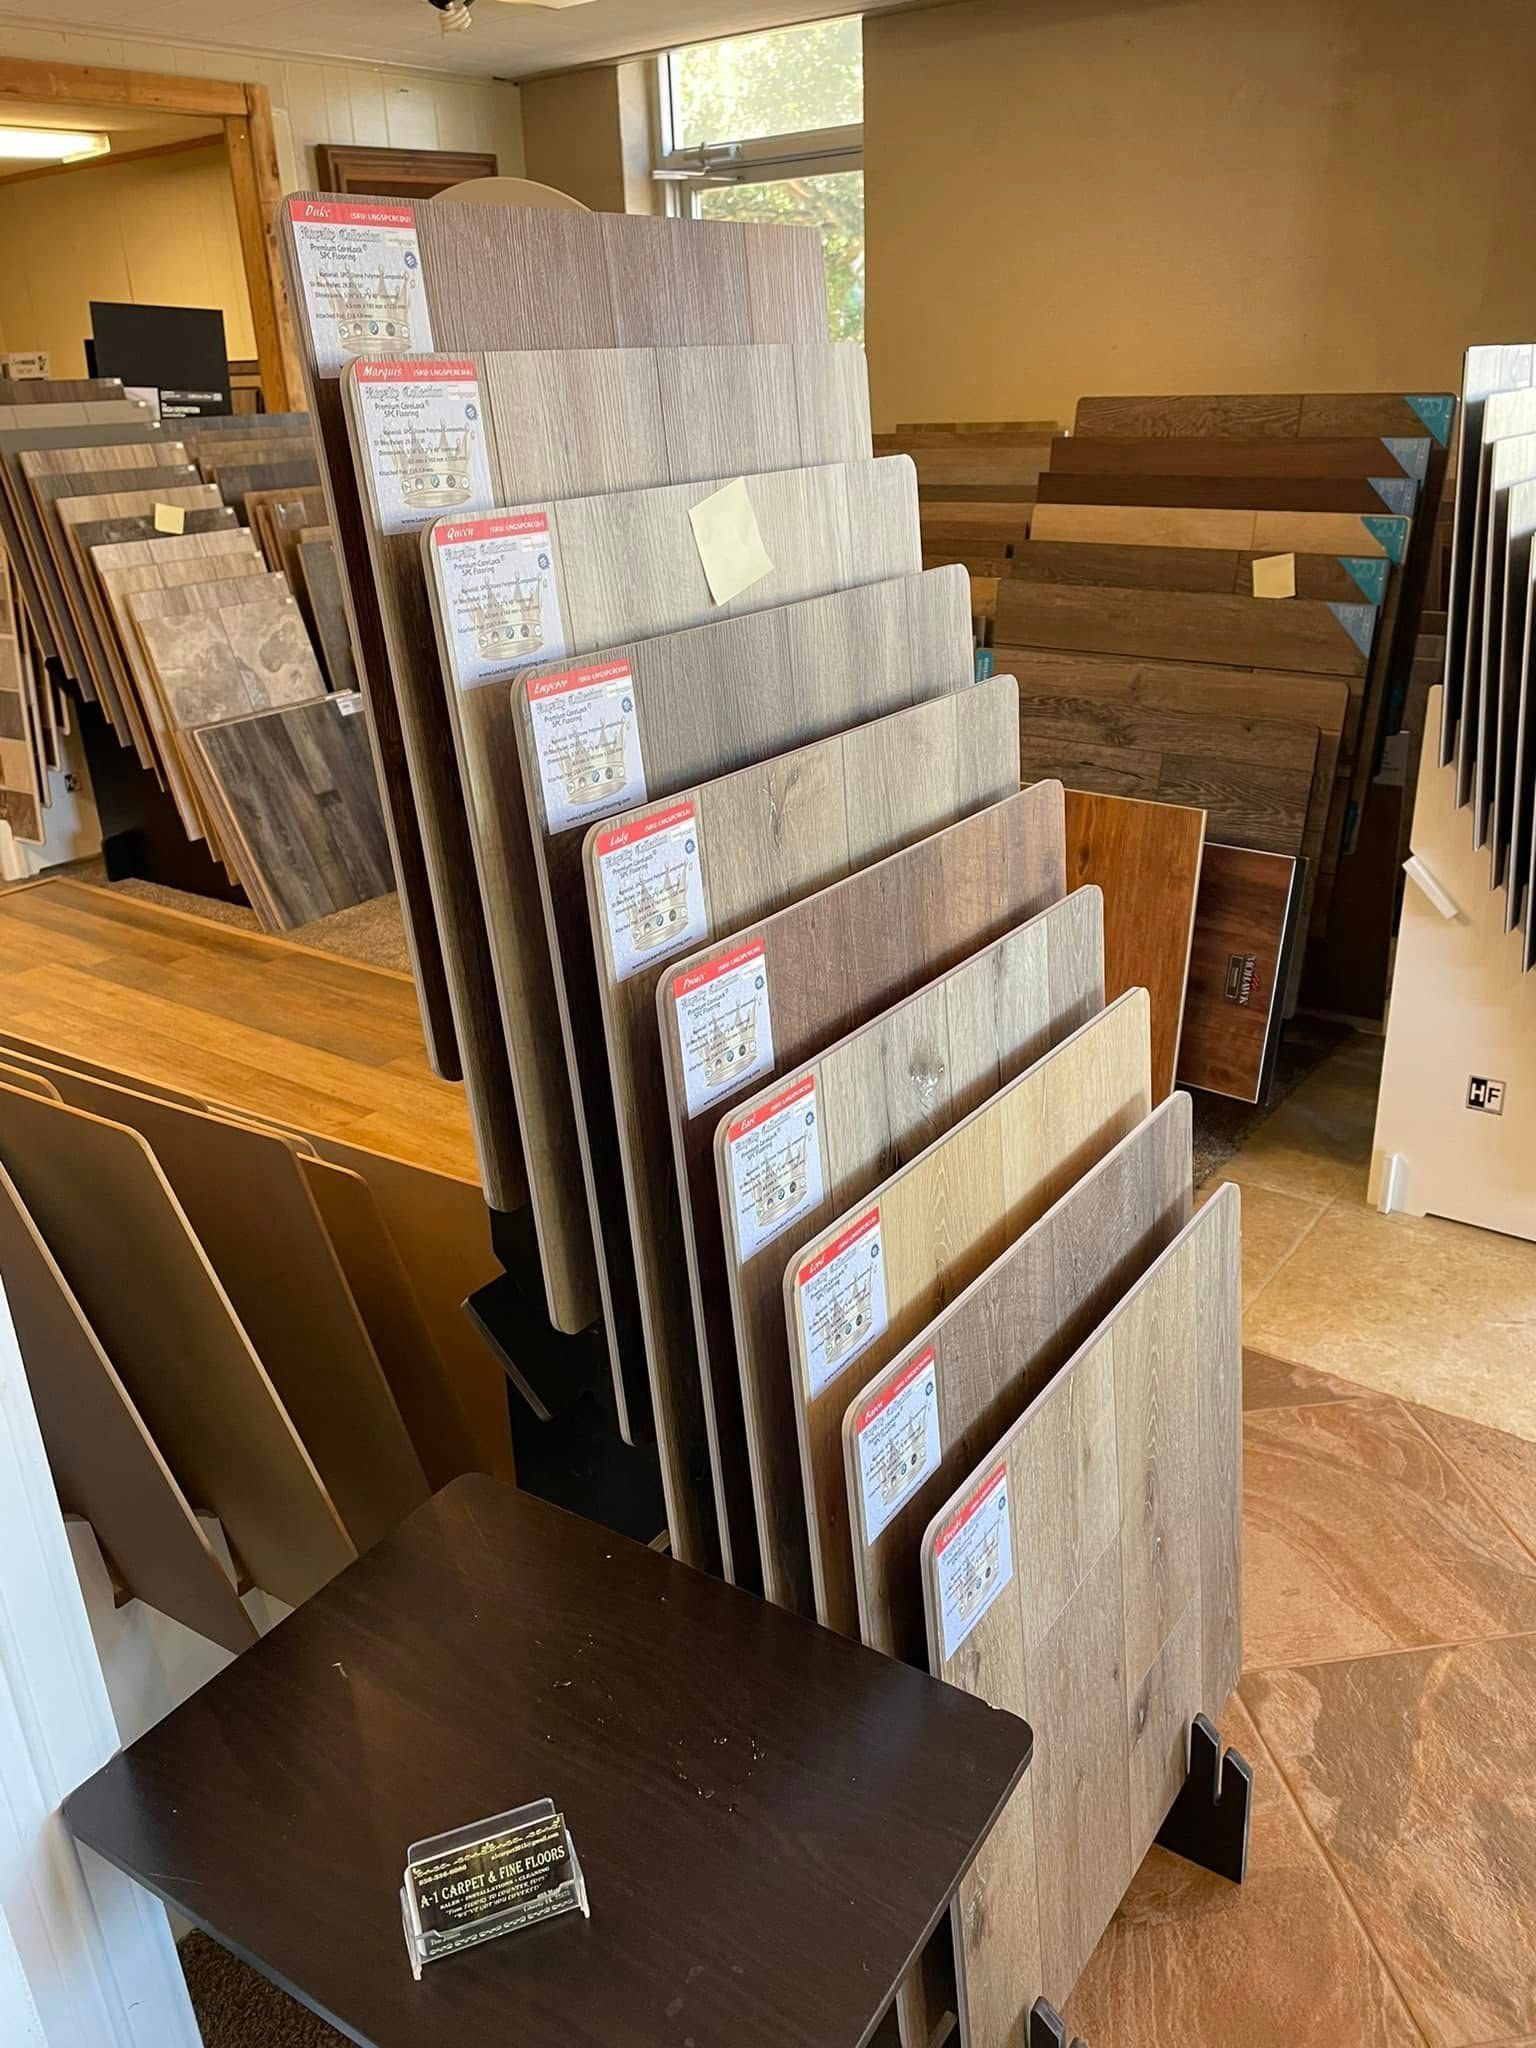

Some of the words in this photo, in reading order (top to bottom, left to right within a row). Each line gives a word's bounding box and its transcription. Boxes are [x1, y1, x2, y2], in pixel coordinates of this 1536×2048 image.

[305, 204, 331, 218] Duke
[310, 243, 337, 252] Premium
[320, 251, 332, 260] SPC
[332, 253, 356, 262] Flooring
[363, 365, 402, 380] Marquis
[375, 402, 399, 410] Premium
[384, 409, 395, 418] SPC
[396, 409, 419, 418] Flooring
[447, 527, 474, 539] Queen
[473, 566, 495, 575] Flooring
[609, 832, 629, 847] Lady
[1239, 952, 1257, 1006] MOHAWK
[420, 1892, 439, 1908] A-1
[442, 1874, 486, 1900] CARPET
[487, 1870, 498, 1883] &
[499, 1861, 524, 1880] FINE
[524, 1845, 566, 1871] FLOORS
[465, 1880, 514, 1901] INSTALLATIONS
[518, 1866, 551, 1882] CLEANING
